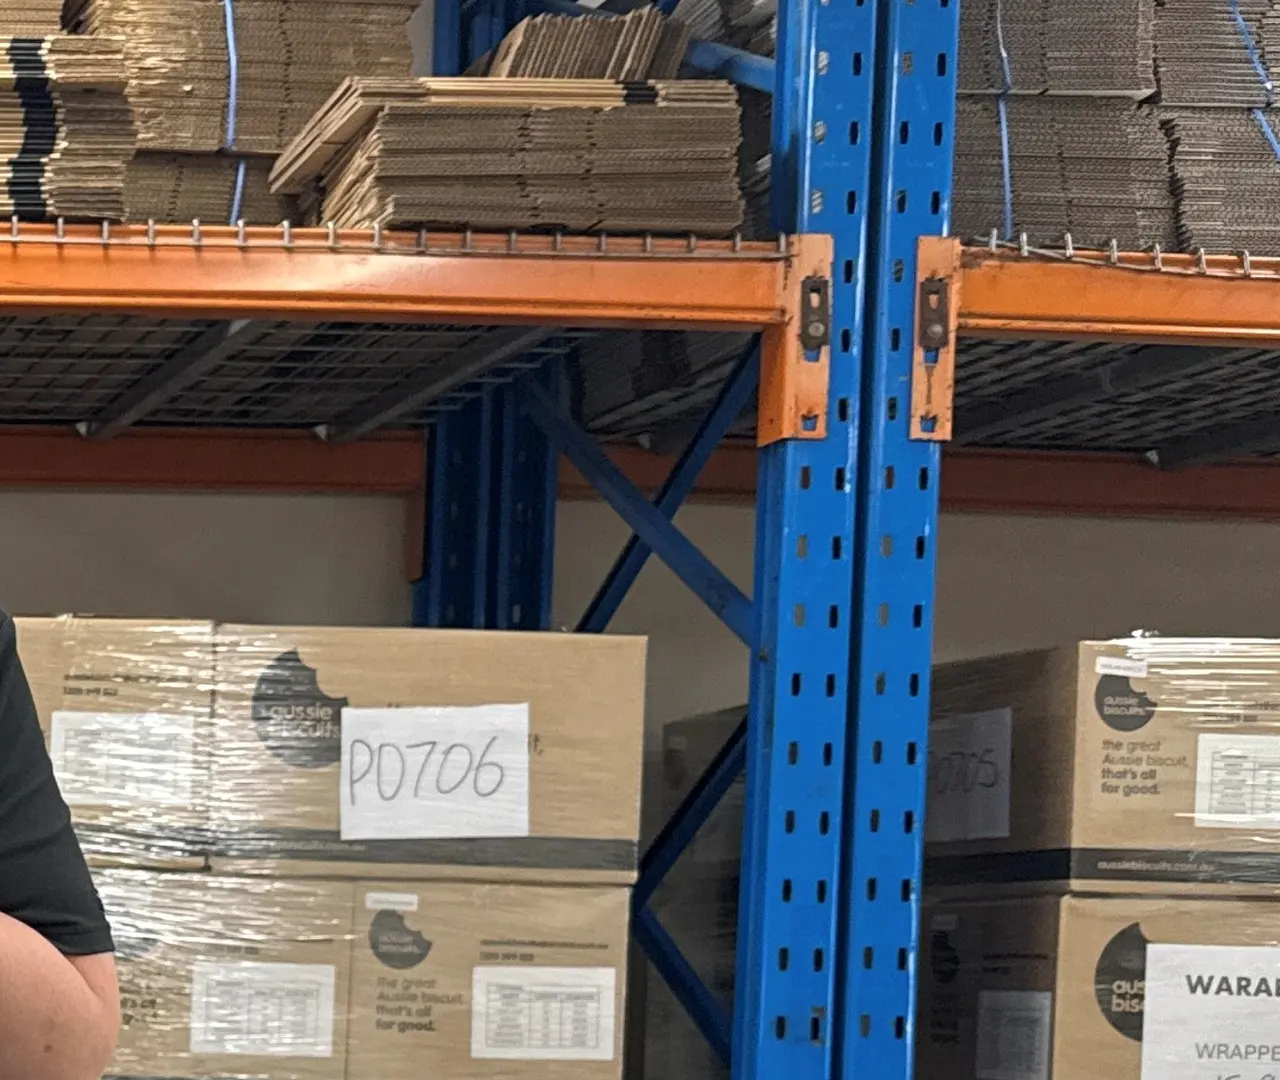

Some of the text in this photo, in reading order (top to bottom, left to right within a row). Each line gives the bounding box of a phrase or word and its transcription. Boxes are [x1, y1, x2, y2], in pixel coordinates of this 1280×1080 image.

[1102, 739, 1162, 754] the great
[1101, 754, 1143, 766] Aussie
[1101, 768, 1158, 781] that's all
[1101, 782, 1161, 797] for good.
[1112, 978, 1145, 995] aus
